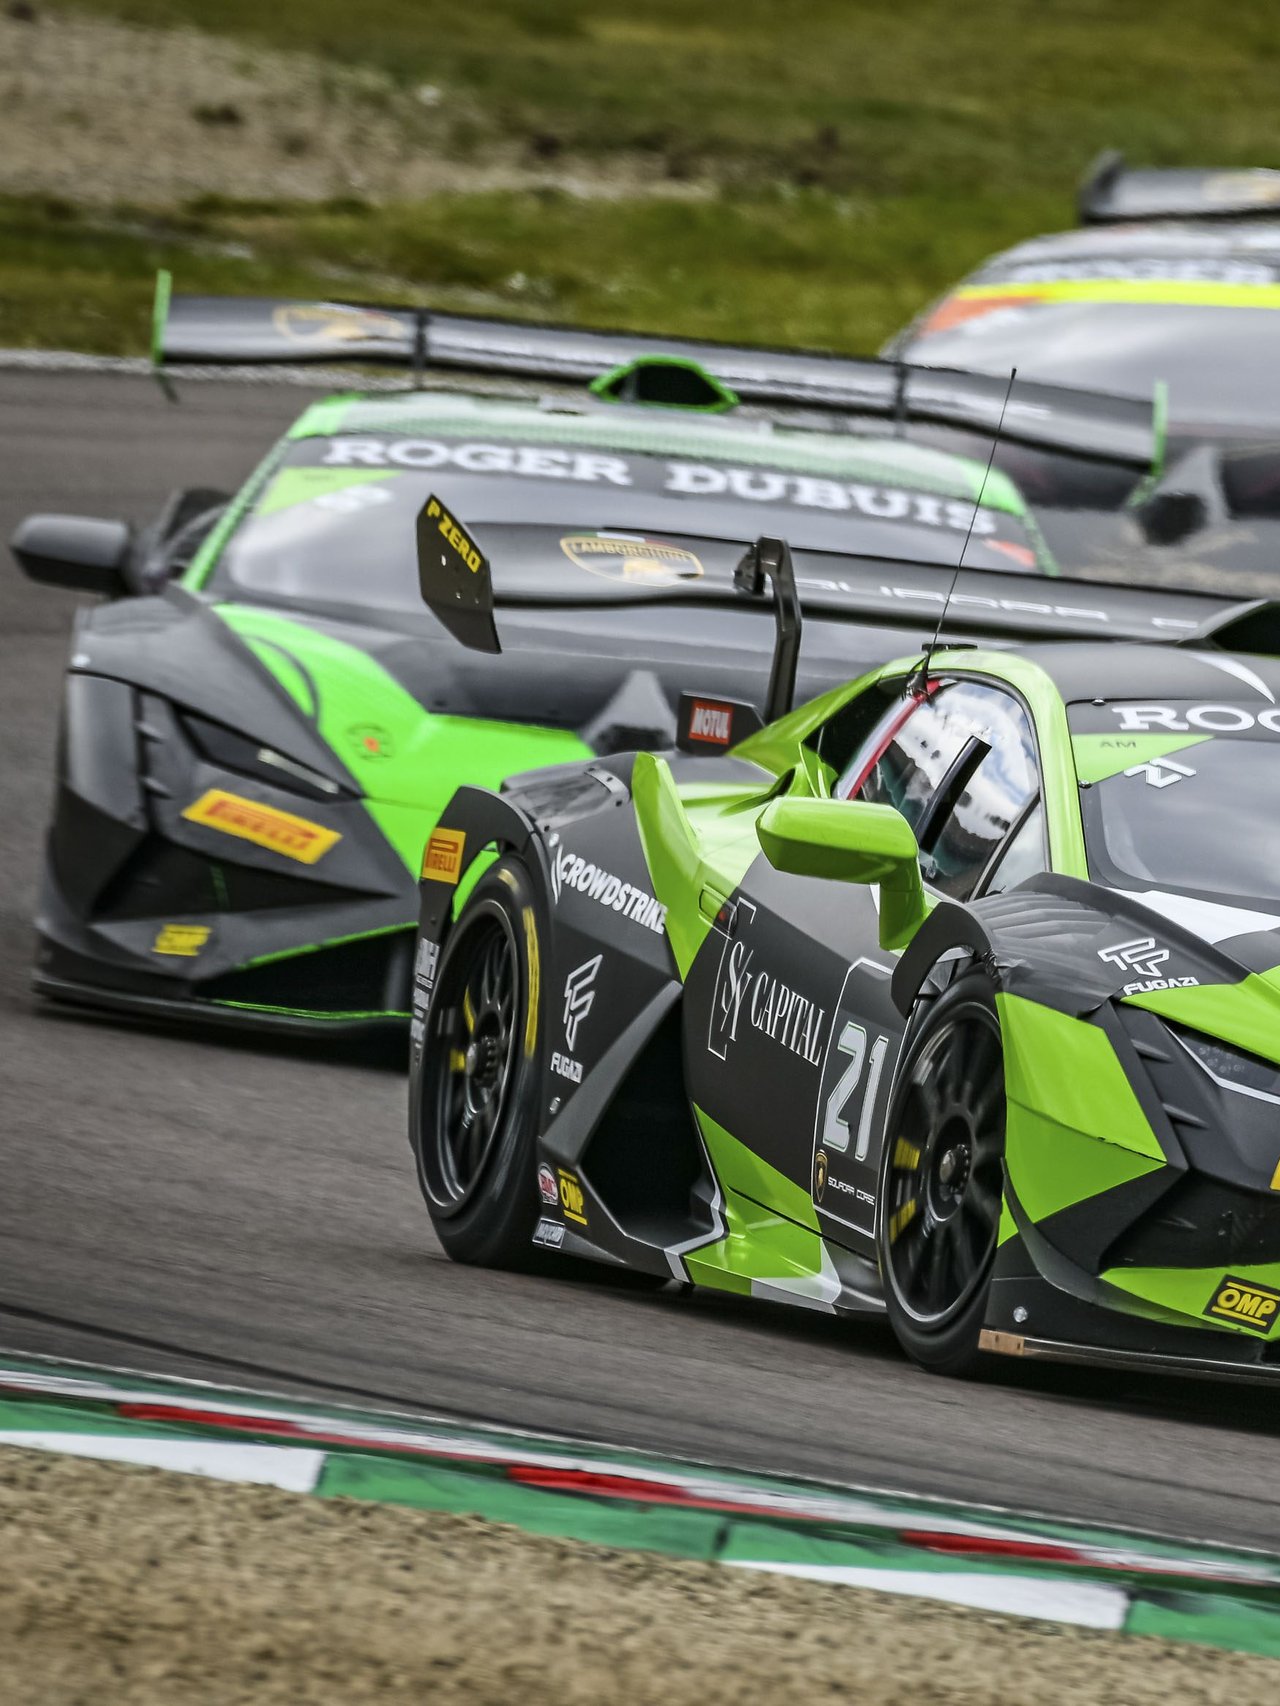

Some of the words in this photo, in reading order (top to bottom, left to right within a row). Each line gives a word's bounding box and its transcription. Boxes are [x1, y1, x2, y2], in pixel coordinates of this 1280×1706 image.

[323, 438, 634, 486] ROGER
[664, 463, 997, 535] DUBUIS
[438, 513, 482, 573] ZERO
[691, 707, 730, 739] MOTUL
[1100, 739, 1137, 749] AM
[425, 838, 459, 874] PIRELLI
[560, 853, 668, 935] CROWDSTRIKE
[1122, 976, 1200, 996] FUGAZI
[751, 972, 826, 1067] CAPITAL
[550, 1051, 585, 1085] FUGAZI
[822, 1021, 889, 1161] 21
[561, 1178, 583, 1214] OMP
[1217, 1288, 1277, 1319] OMP
